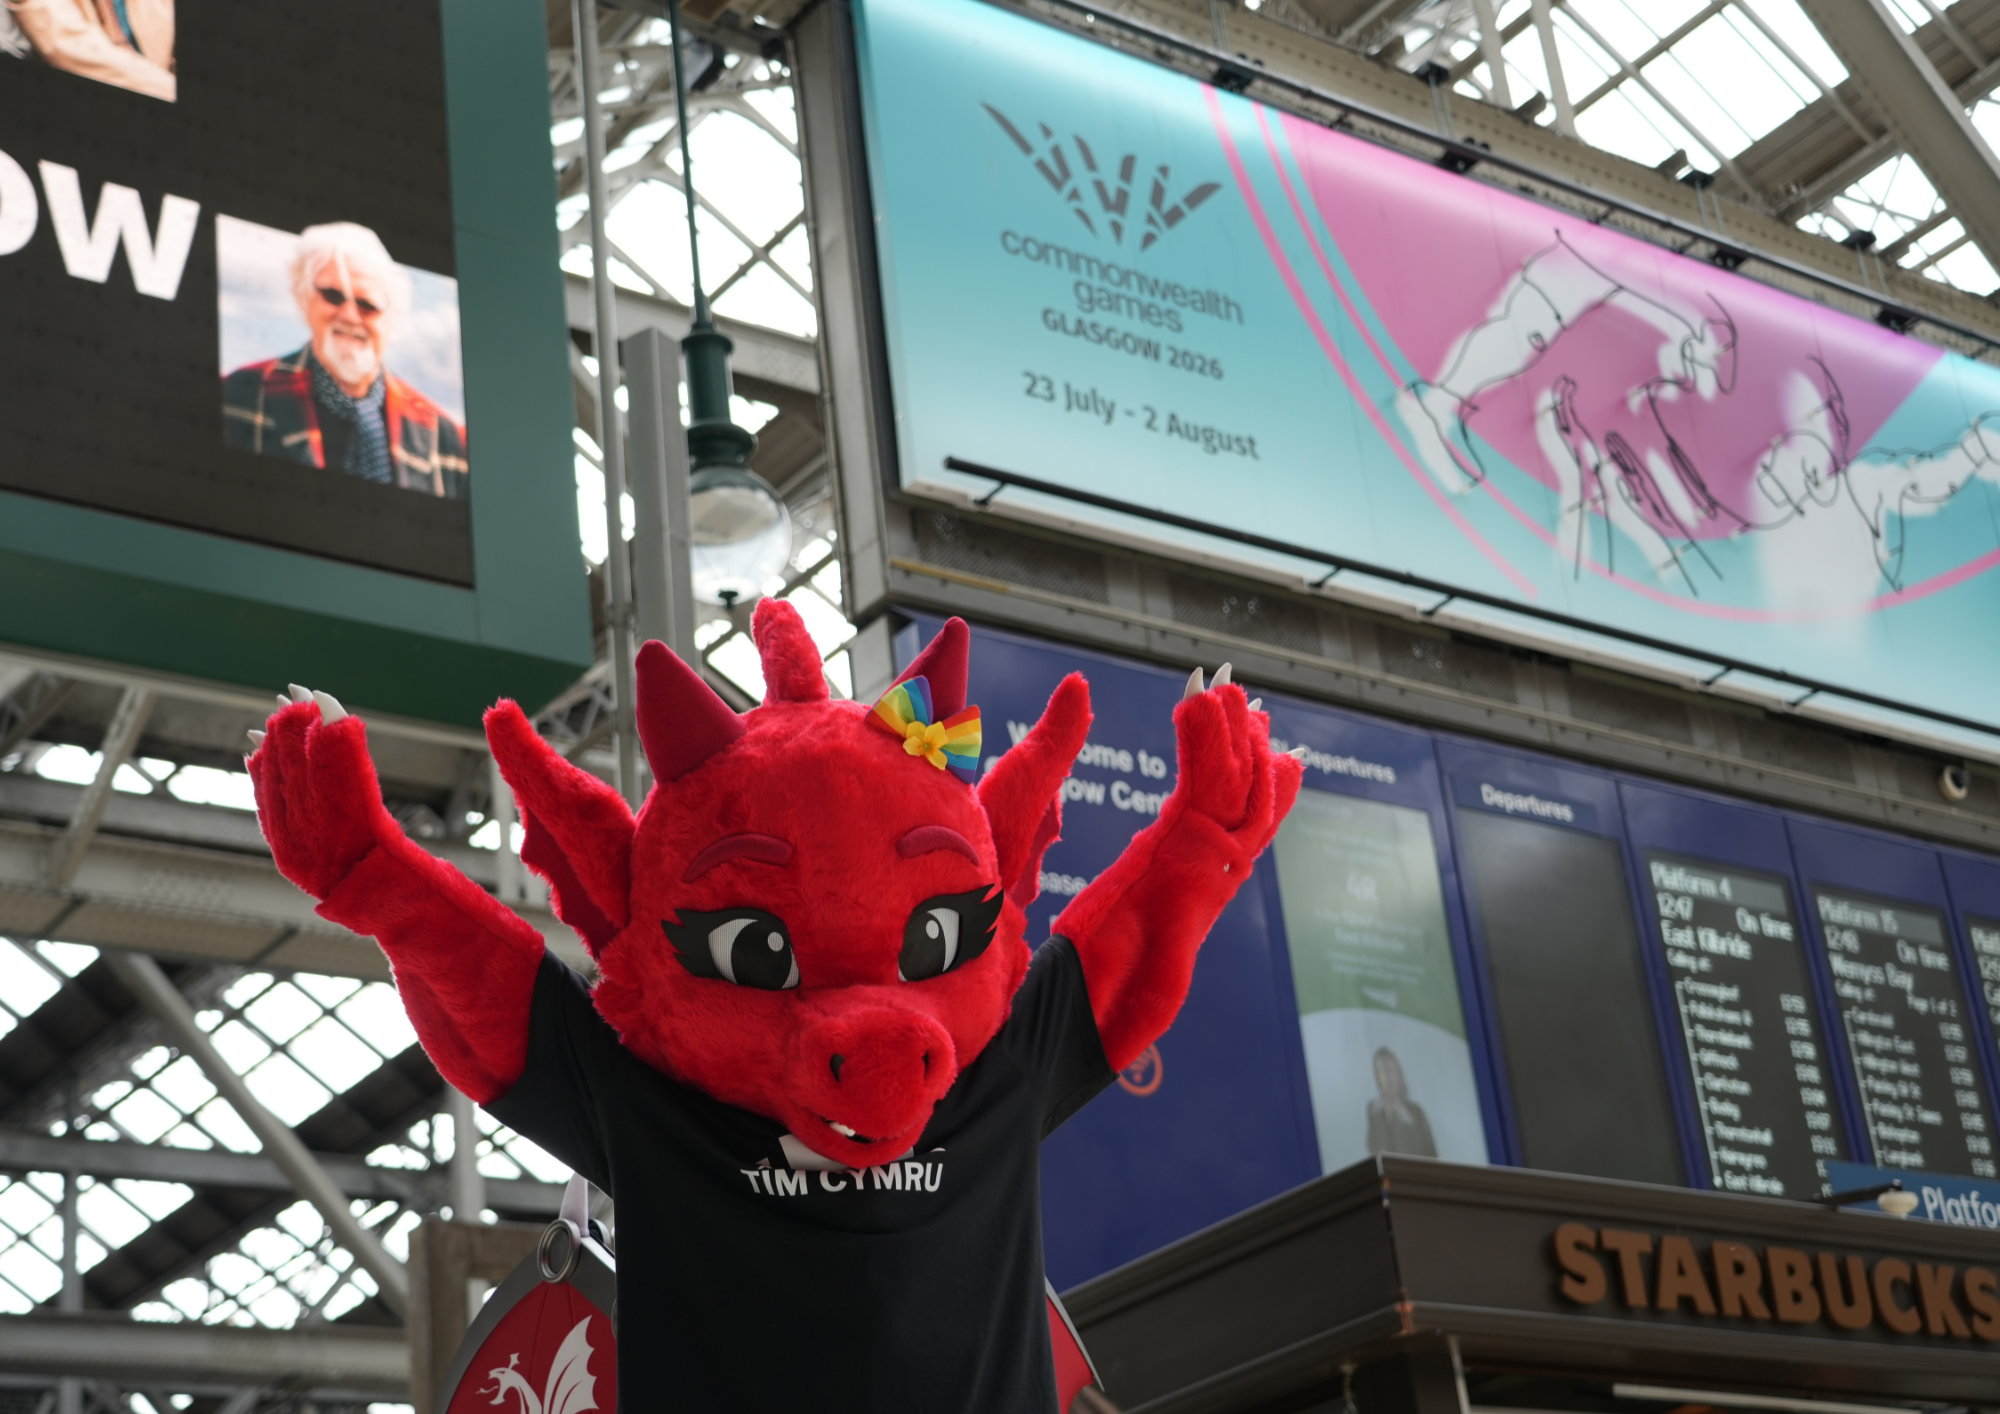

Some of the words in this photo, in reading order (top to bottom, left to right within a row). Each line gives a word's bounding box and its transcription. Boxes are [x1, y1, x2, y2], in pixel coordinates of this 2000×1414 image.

[1000, 229, 1244, 326] commonwealth
[1073, 279, 1184, 334] games
[1041, 308, 1160, 362] GLASGOW
[1166, 345, 1225, 381] 2026
[1023, 370, 1056, 402] 23
[1064, 381, 1115, 426] July
[1142, 404, 1159, 432] 2
[1166, 412, 1261, 461] August
[1137, 748, 1167, 779] to
[1299, 743, 1398, 785] Departures
[1480, 782, 1575, 823] Departures
[1651, 861, 1718, 899] Platform
[1719, 876, 1733, 901] 4
[1735, 906, 1761, 935] On
[1759, 912, 1794, 942] time
[1816, 895, 1881, 932] Platform
[1880, 908, 1899, 935] 15
[1896, 938, 1919, 966] On
[1917, 943, 1950, 972] time
[818, 1160, 944, 1193] CYMRU
[1554, 1221, 2000, 1342] STARBUCKS
